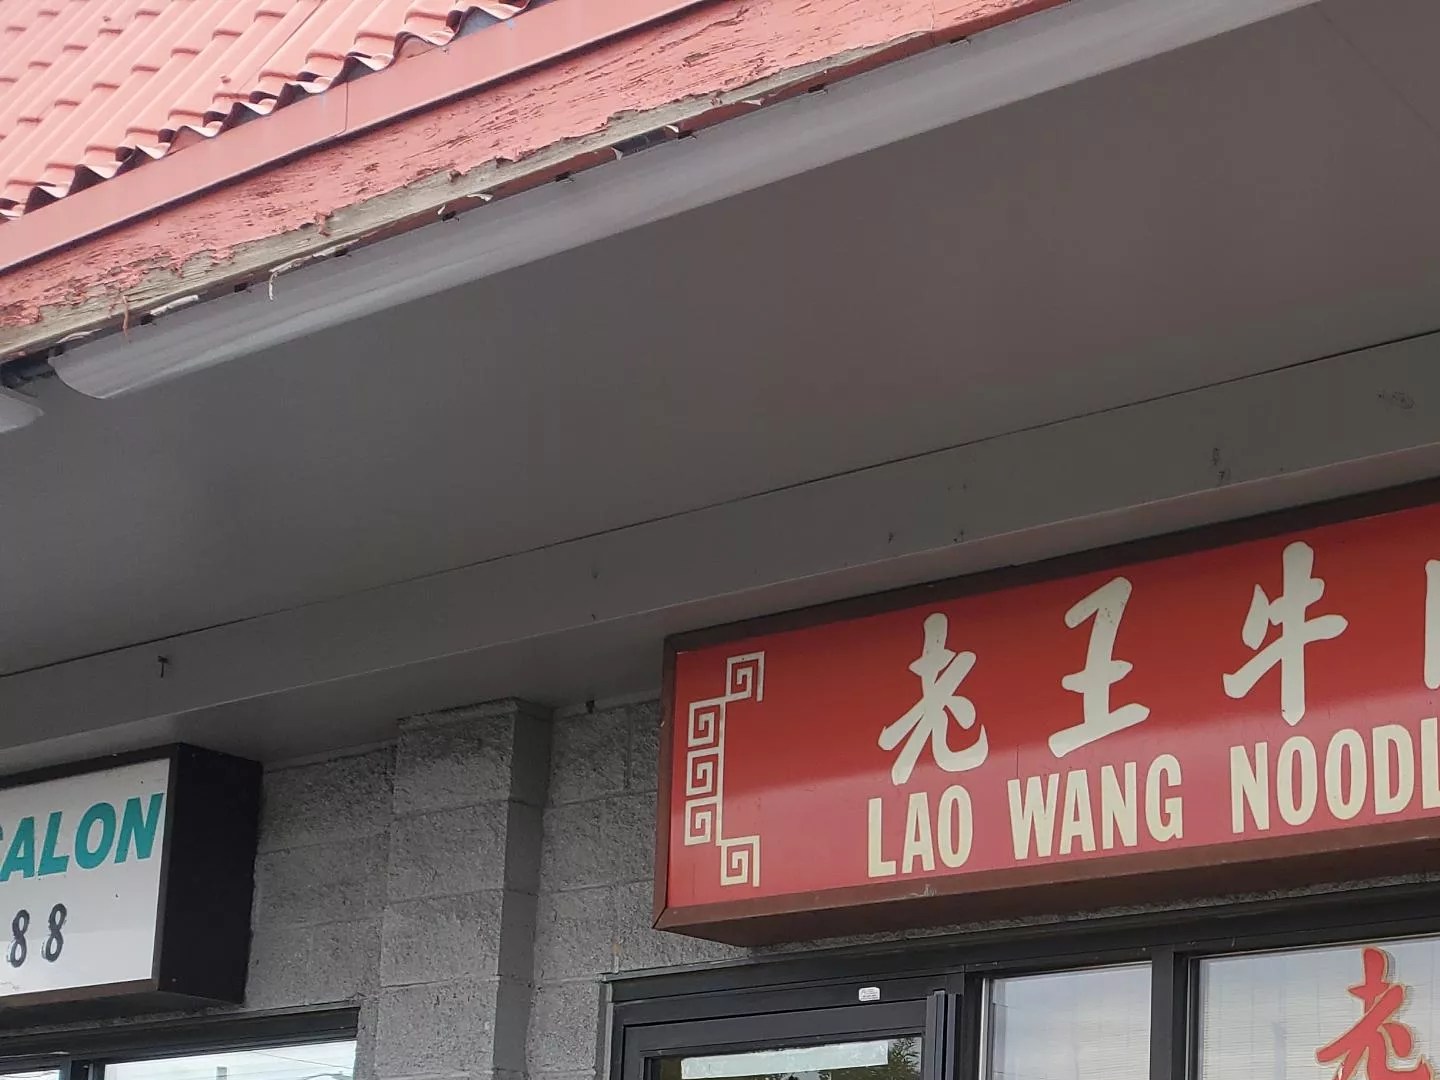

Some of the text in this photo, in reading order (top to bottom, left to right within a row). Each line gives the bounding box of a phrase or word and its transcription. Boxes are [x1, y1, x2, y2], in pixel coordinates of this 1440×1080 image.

[0, 792, 164, 882] ALON
[866, 784, 974, 878] LAO
[1005, 752, 1185, 861] WANG
